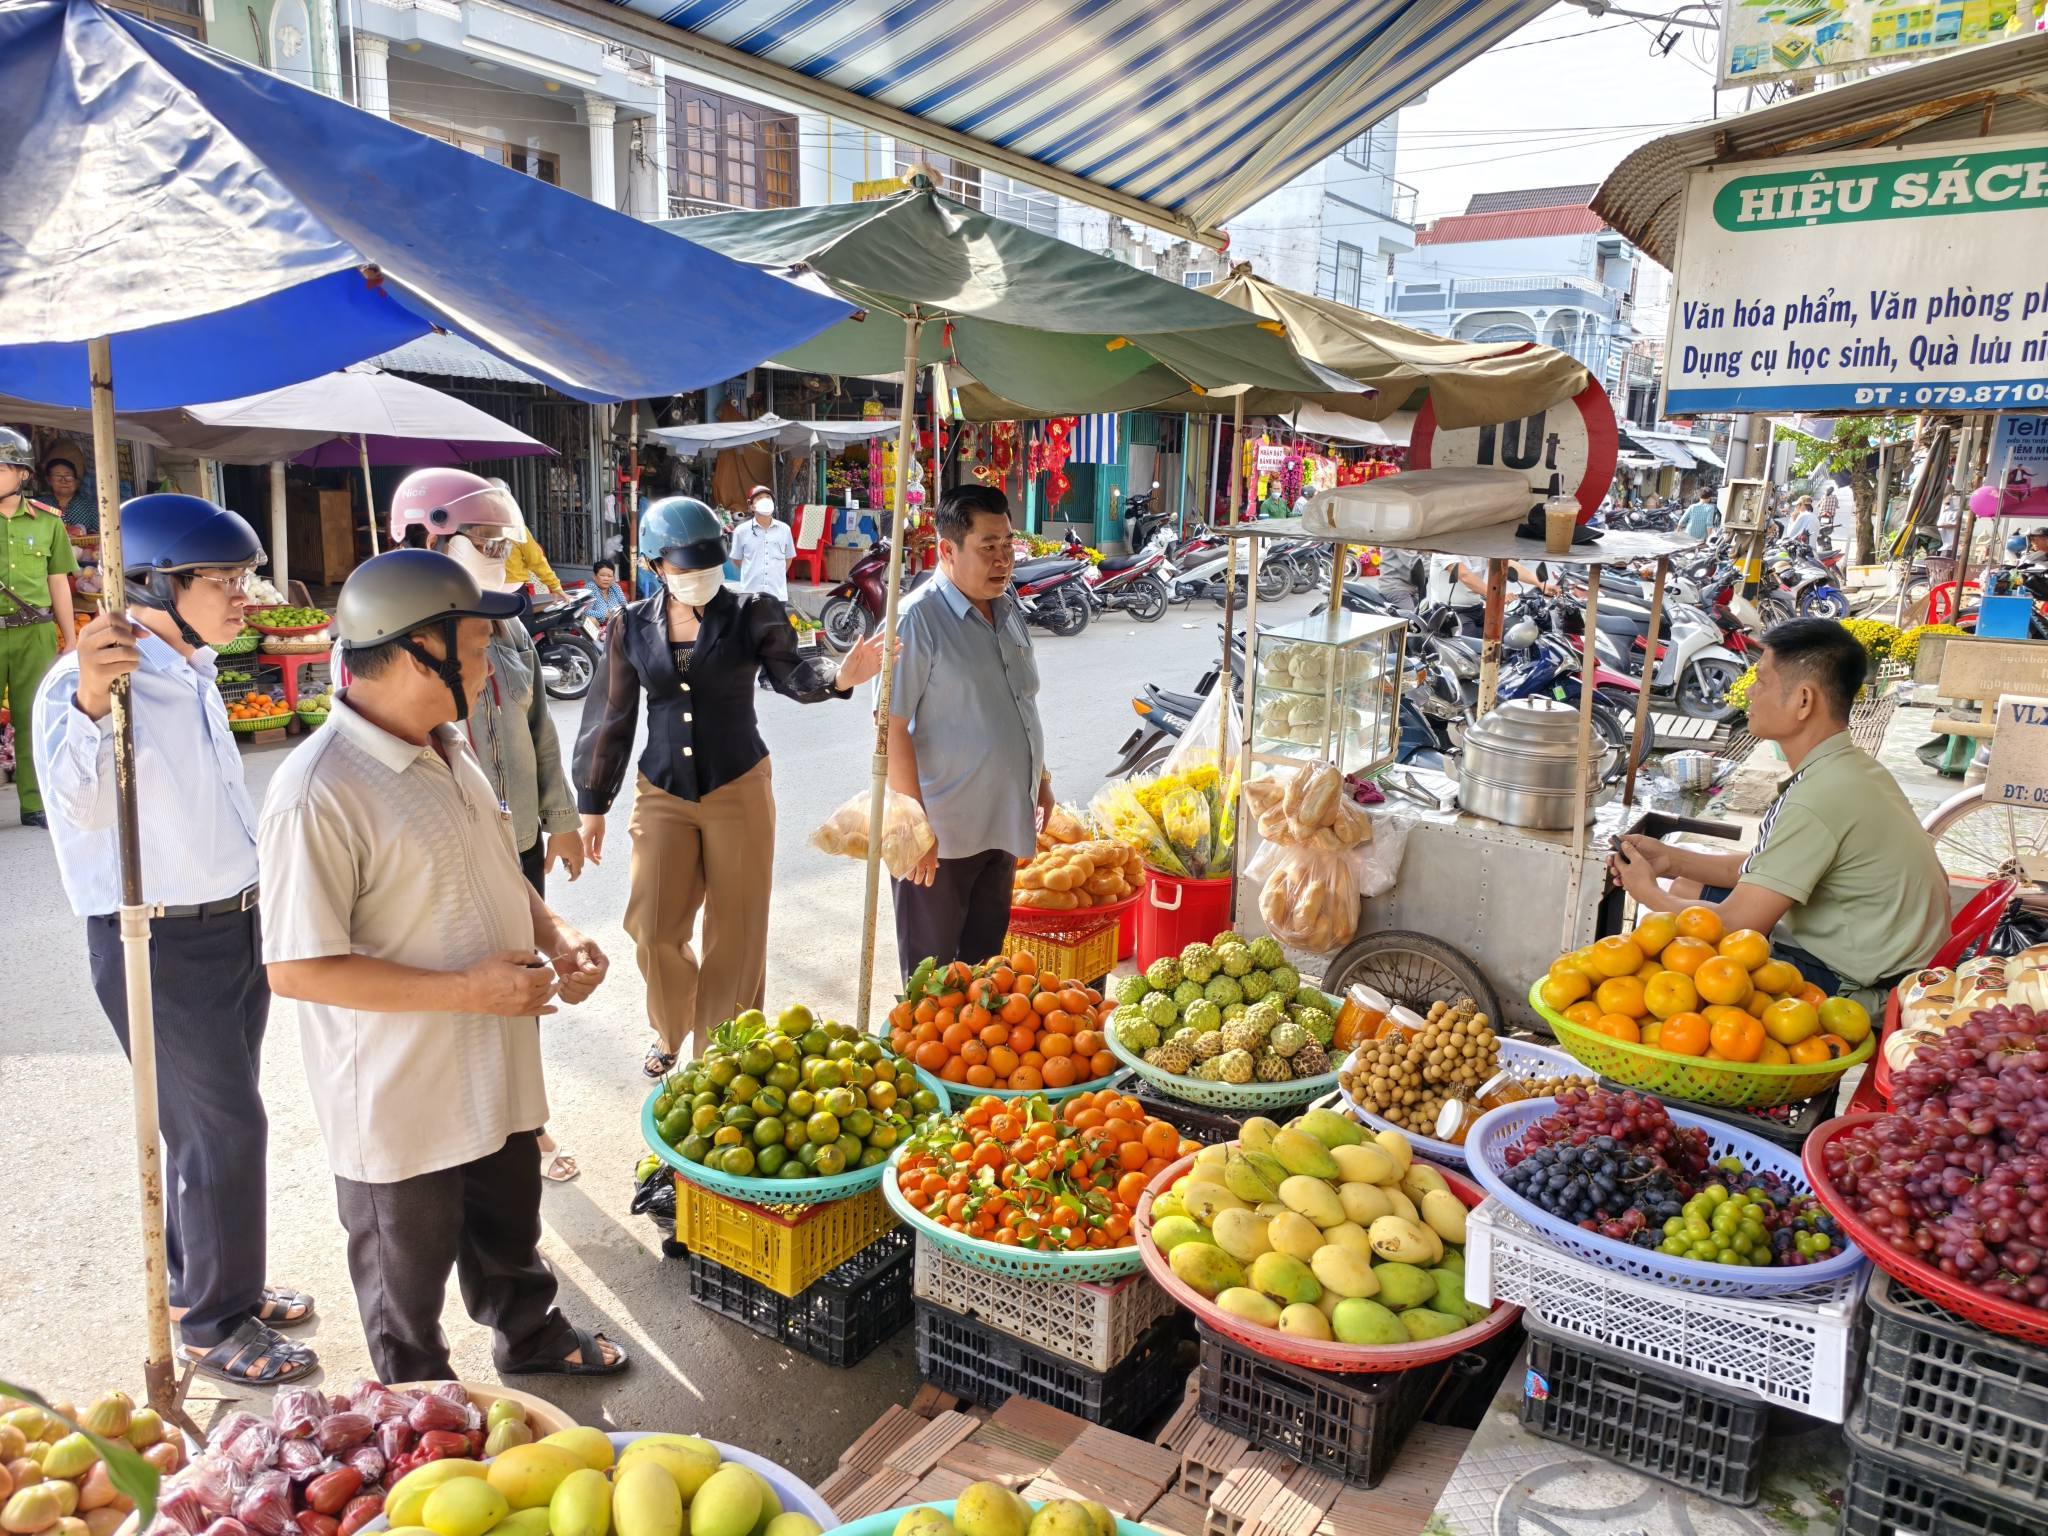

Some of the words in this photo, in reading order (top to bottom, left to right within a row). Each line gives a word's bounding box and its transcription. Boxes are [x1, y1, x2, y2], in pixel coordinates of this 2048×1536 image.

[1737, 172, 1879, 225] HIỆU
[1683, 301, 1725, 330] Văn
[1733, 298, 1775, 328] hóa
[1783, 287, 1858, 330] phẩm,
[1870, 290, 1917, 321] Văn
[1926, 285, 2014, 325] phòng
[1683, 345, 1743, 379] Dụng
[1751, 349, 1778, 377] cụ
[1786, 340, 1831, 375] học
[1838, 337, 1898, 373] sinh,
[1909, 334, 1960, 372] Quà
[1969, 333, 2012, 365] lưu
[2021, 330, 2048, 363] ni
[1915, 383, 2048, 404] 079.8710
